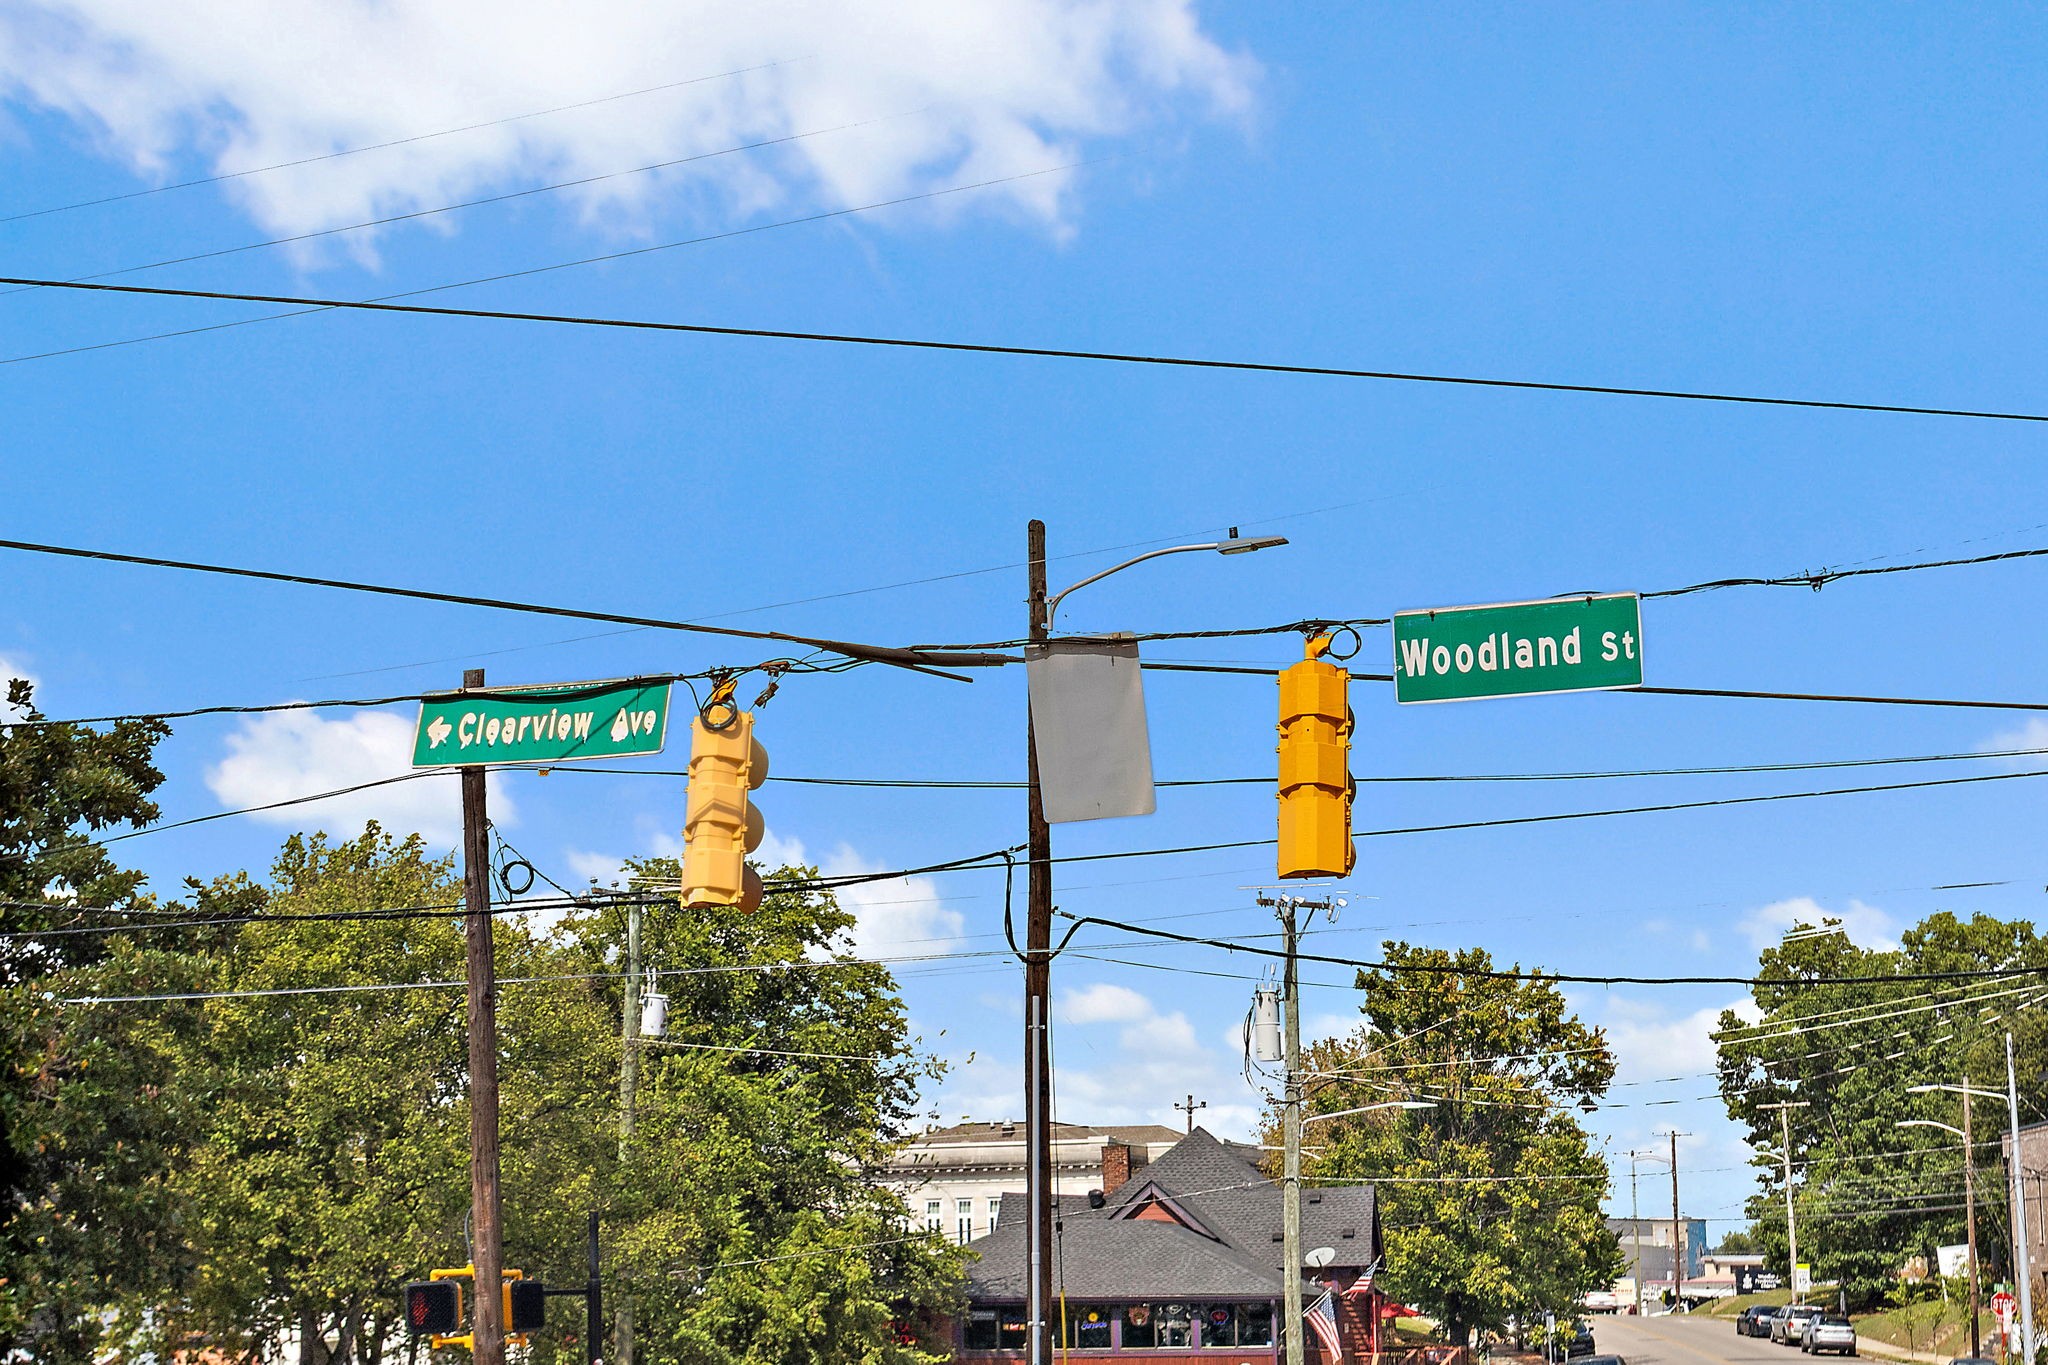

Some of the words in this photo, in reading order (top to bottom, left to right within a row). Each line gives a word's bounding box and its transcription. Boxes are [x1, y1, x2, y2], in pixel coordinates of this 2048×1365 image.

[1400, 625, 1582, 678] Woodland
[1601, 630, 1635, 661] St
[458, 707, 594, 750] Clearview
[610, 707, 657, 743] Ave
[1993, 1298, 2015, 1310] STOP
